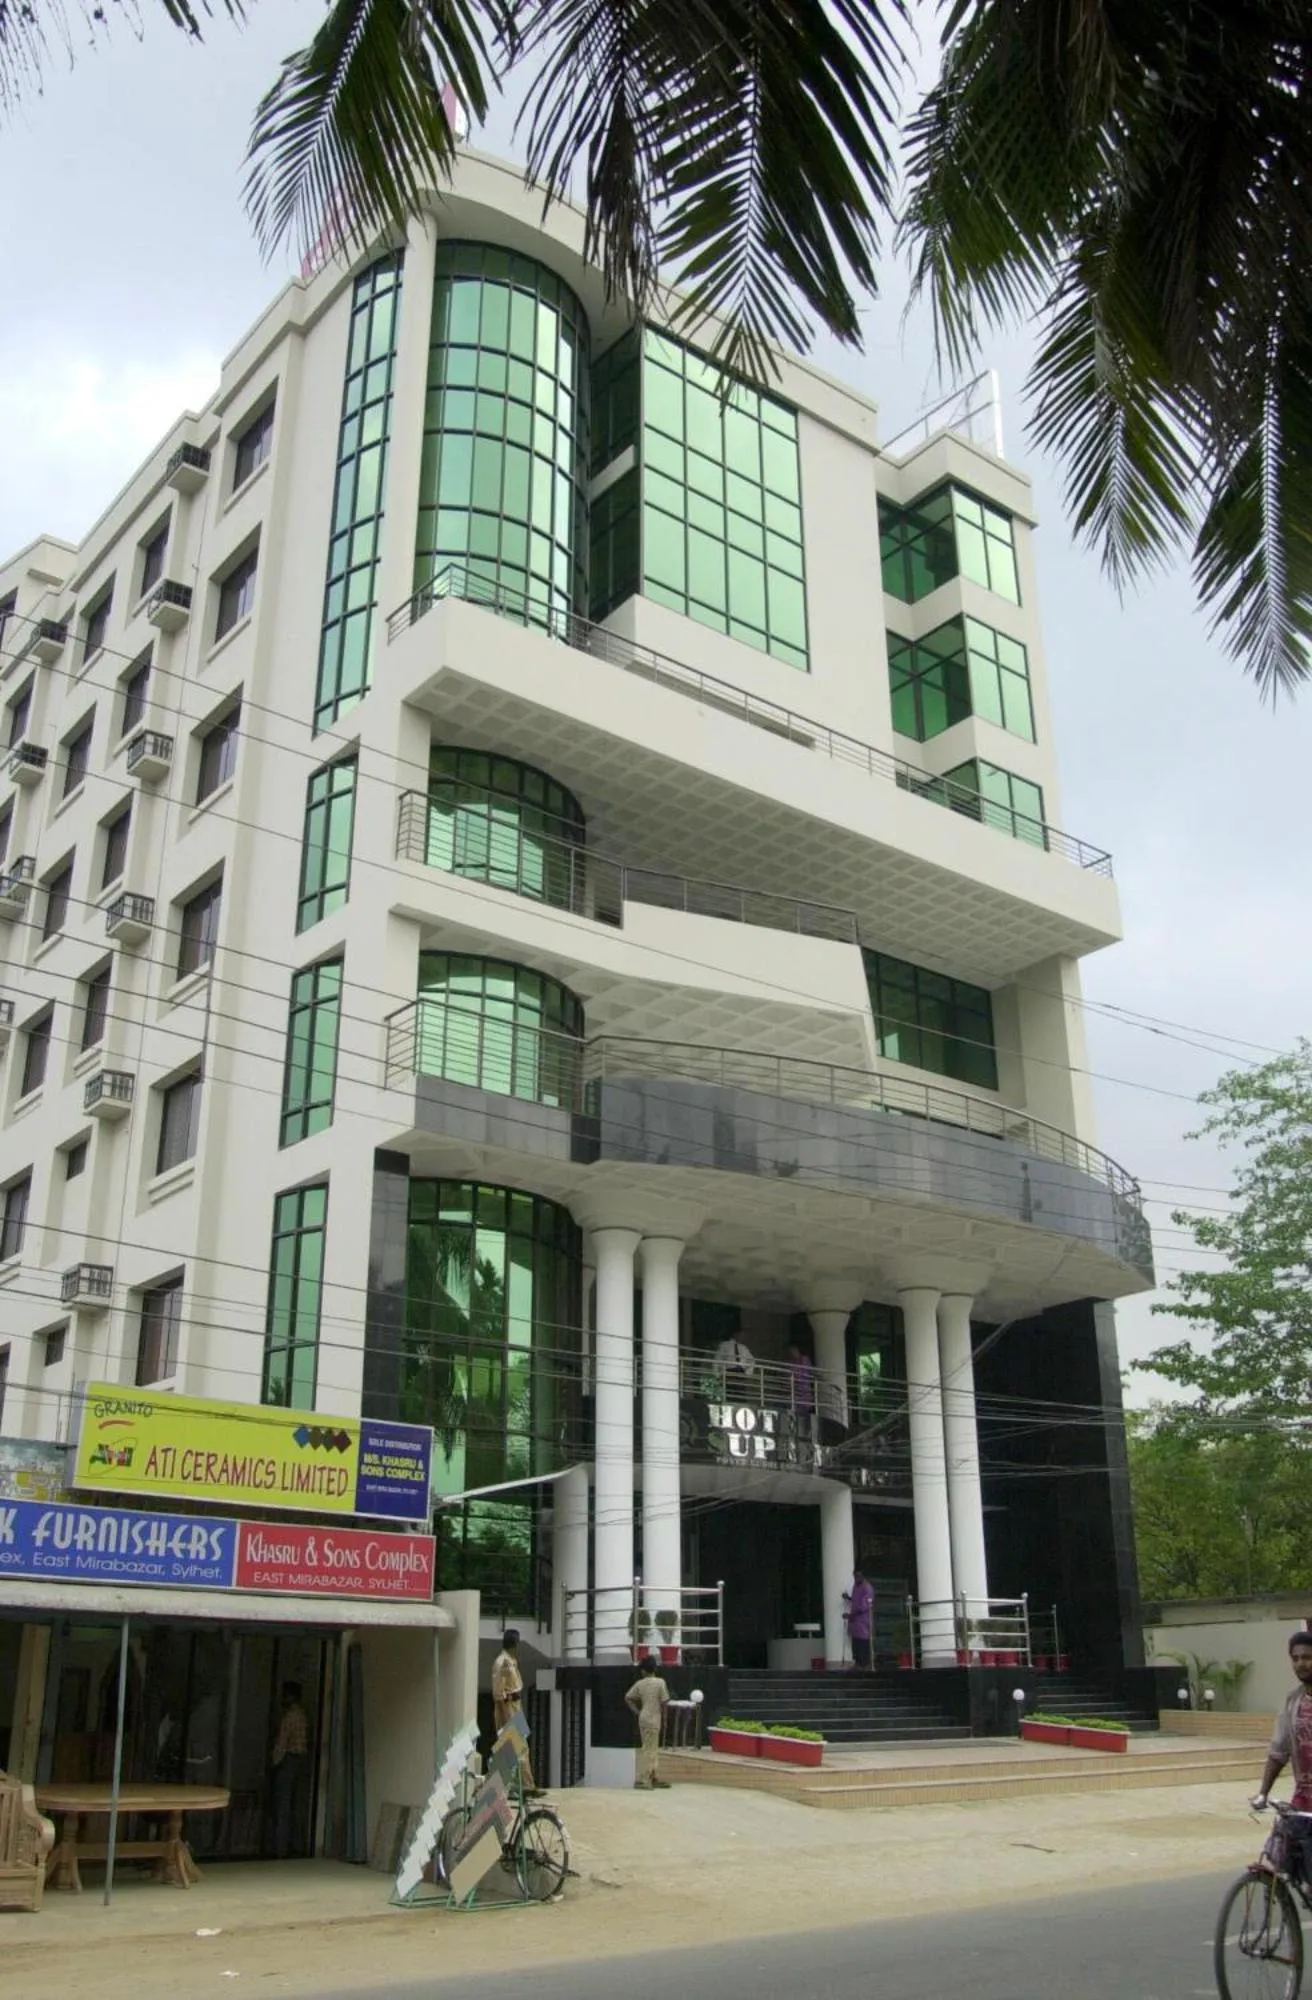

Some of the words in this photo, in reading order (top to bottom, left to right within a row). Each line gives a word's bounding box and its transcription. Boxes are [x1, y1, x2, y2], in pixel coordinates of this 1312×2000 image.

[94, 1400, 153, 1418] GRANITO
[145, 1446, 177, 1479] ATI
[181, 1449, 276, 1490] CERAMICS
[281, 1461, 349, 1497] LIMITED
[32, 1511, 227, 1561] FURNISHERS
[33, 1552, 70, 1568] East
[246, 1531, 299, 1565] Khasru
[305, 1536, 318, 1567] &
[323, 1539, 360, 1569] Sons
[365, 1542, 429, 1578] Complex
[254, 1571, 284, 1584] EAST
